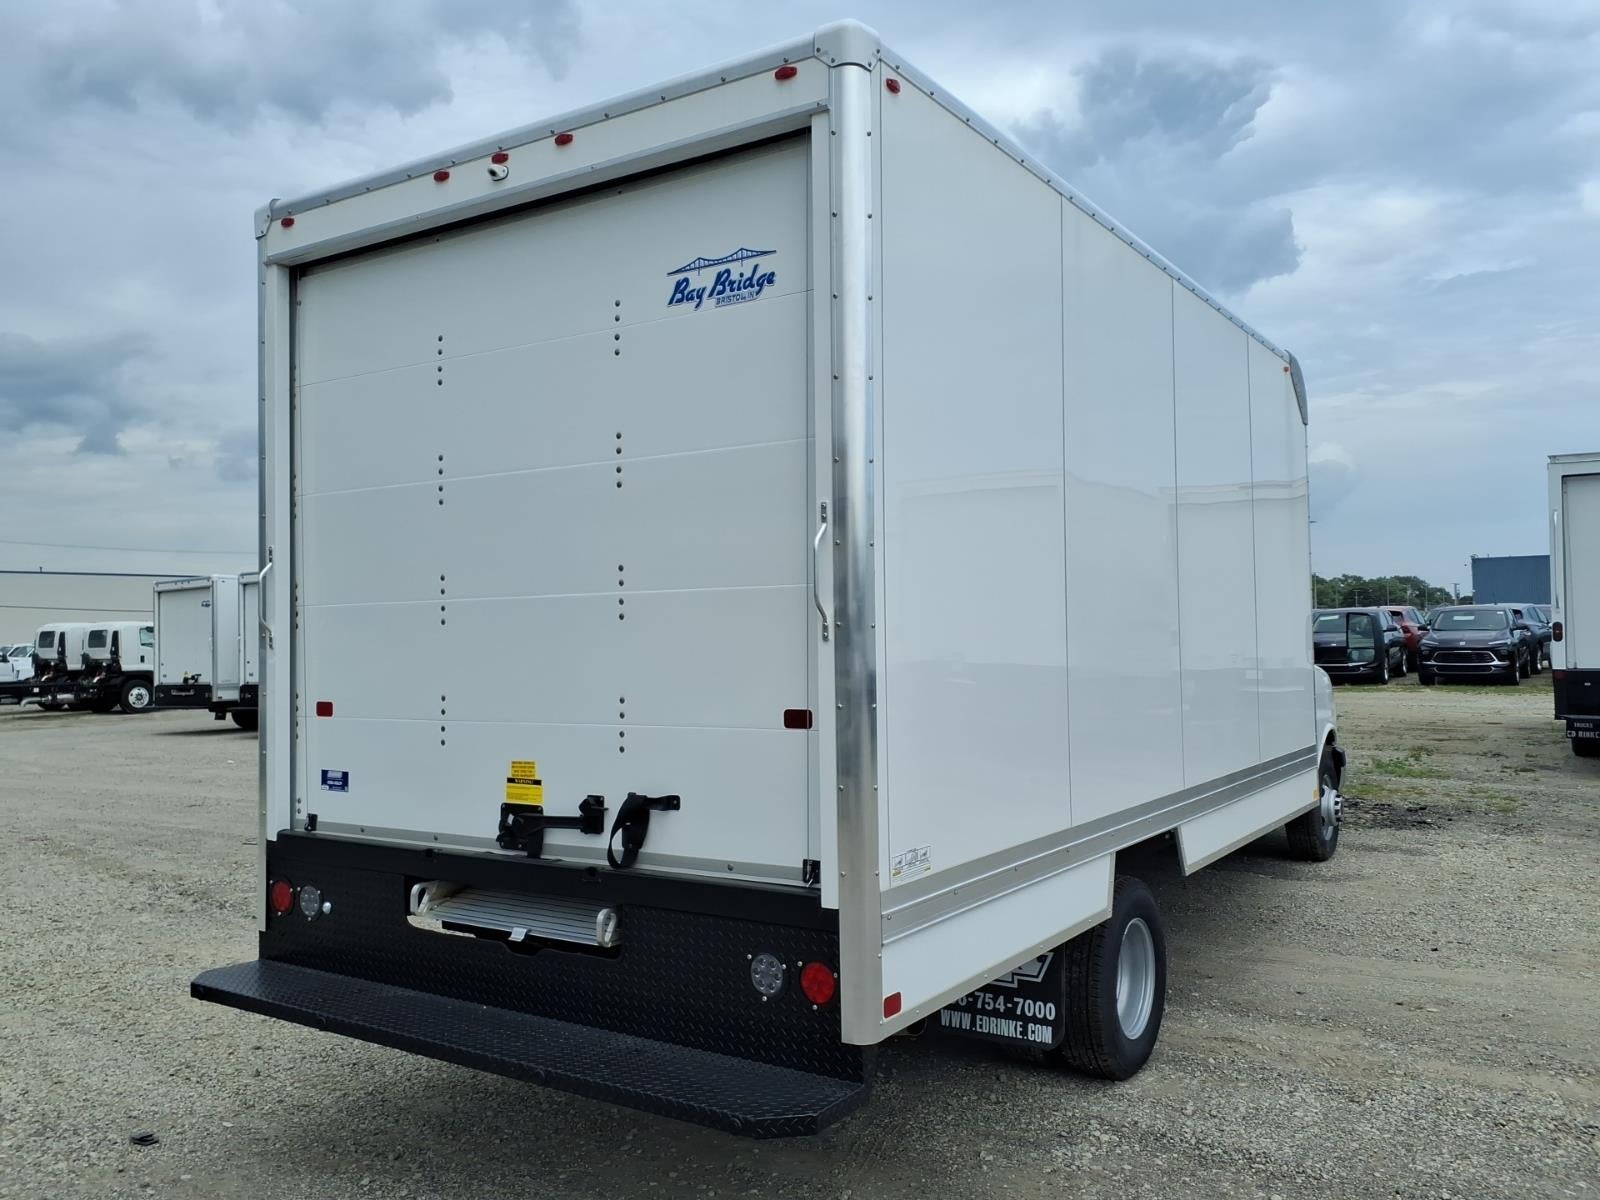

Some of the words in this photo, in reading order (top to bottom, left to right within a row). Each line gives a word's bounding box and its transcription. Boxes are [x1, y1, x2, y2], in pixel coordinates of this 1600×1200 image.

[667, 277, 707, 310] Bay
[707, 263, 776, 297] Bridge
[940, 1008, 1053, 1044] WWW.EDRINKE.COM
